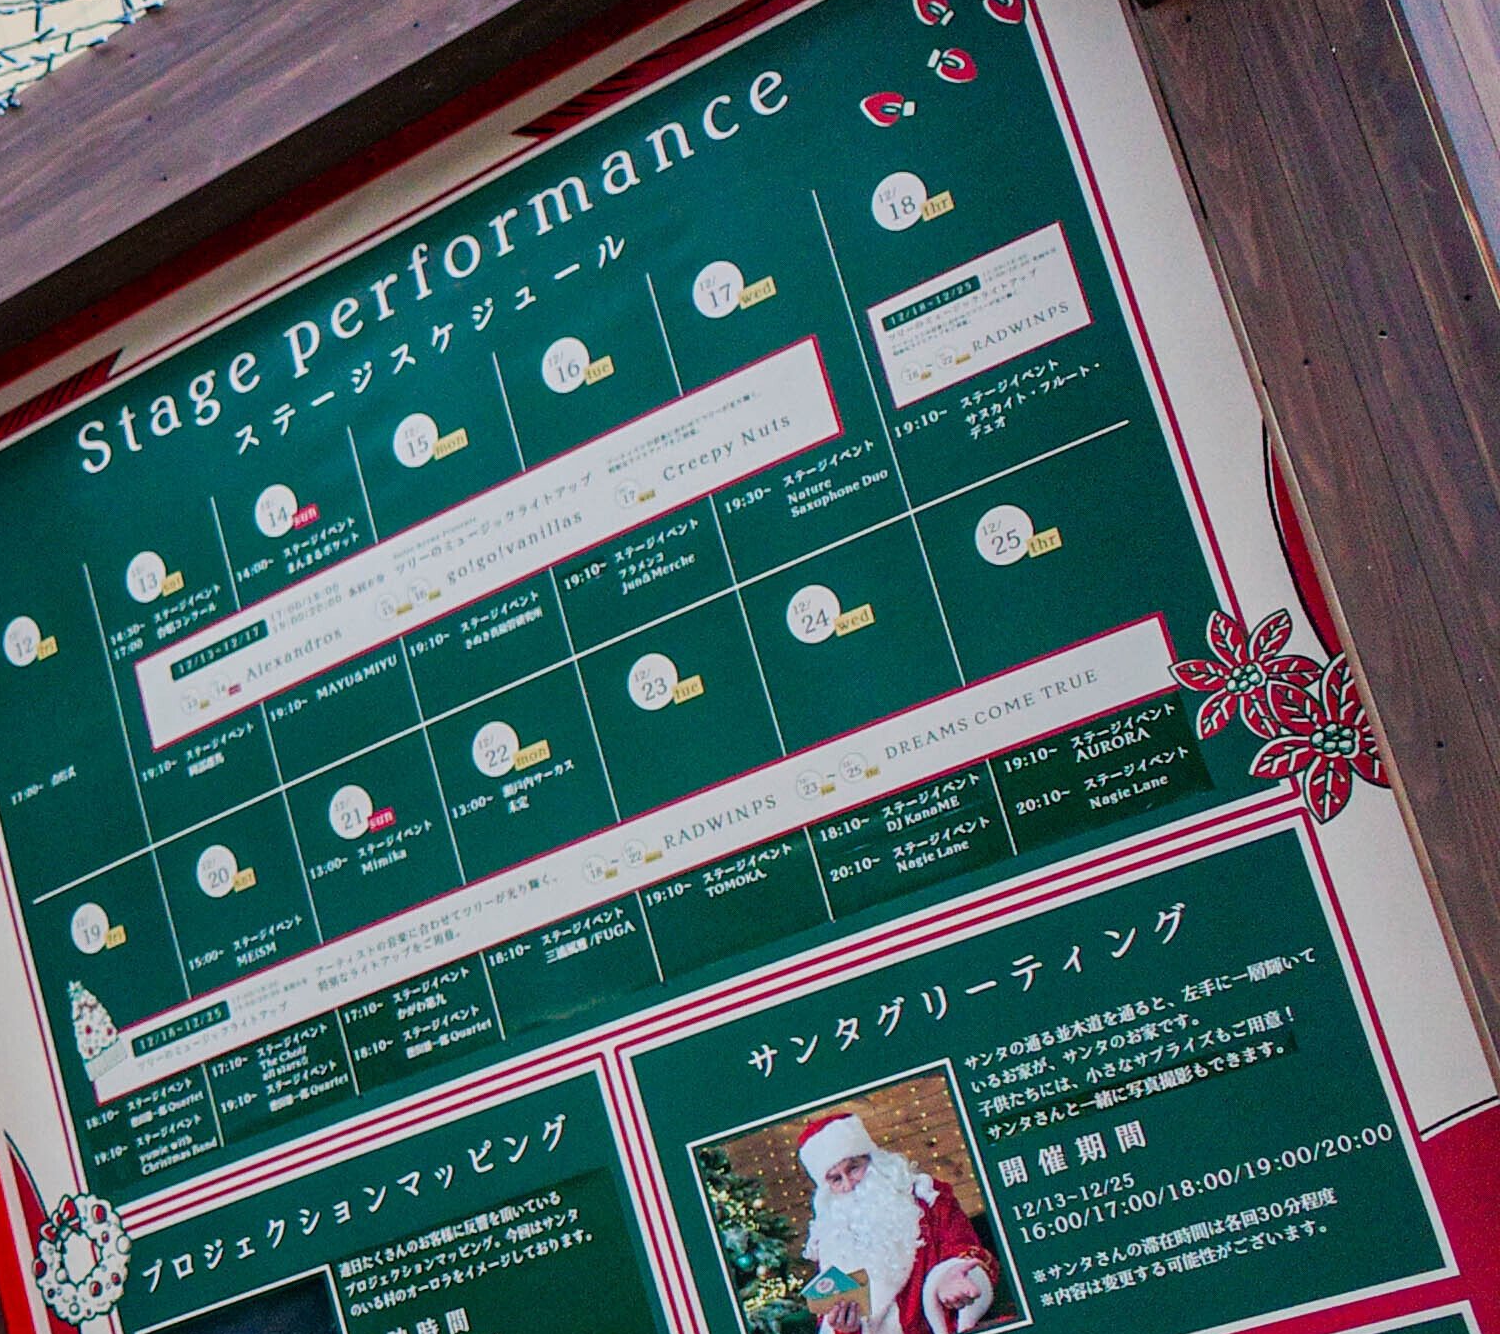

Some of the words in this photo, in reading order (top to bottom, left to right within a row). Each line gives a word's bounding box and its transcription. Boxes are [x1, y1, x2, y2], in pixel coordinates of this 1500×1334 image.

[79, 353, 260, 473] Stage
[284, 72, 787, 378] performance
[236, 236, 624, 454] ステージスケジュール
[895, 410, 947, 438] 19:10~
[960, 360, 1058, 409] ステージイベント
[663, 441, 732, 481] Creepy
[741, 416, 790, 445] Nuts
[783, 440, 873, 487] ステージイベント
[791, 482, 860, 517] Saxophone
[615, 519, 698, 562] ステージイベント
[885, 718, 968, 759] DREAMS
[975, 692, 1035, 724] COME
[1041, 669, 1097, 699] TRUE
[1004, 748, 1057, 772] 19:10~
[1071, 704, 1174, 752] ステージイベント
[1076, 728, 1150, 763] AURORA
[882, 774, 979, 818] ステージイベント
[1016, 790, 1070, 815] 20:10~
[1084, 747, 1188, 790] ステージイベント
[703, 843, 792, 884] ステージイベント
[893, 817, 989, 859] ステージイベント
[542, 907, 623, 946] ステージイベント
[748, 903, 1185, 1077] サンタグリーティング
[971, 1014, 1199, 1093] いるお家が、サンタのお家です。
[988, 1042, 1283, 1139] サンタさんと一緒に写真撮影もできます。
[998, 1121, 1145, 1187] 開催期間
[1020, 1124, 1392, 1243] 16:00/17:00/18:00/19:00/20:00
[143, 1114, 565, 1292] プロジェクションマッピング
[1012, 1173, 1134, 1220] 12/13~12/25
[1040, 1220, 1326, 1306] ※内容は変更する可能性がございます。
